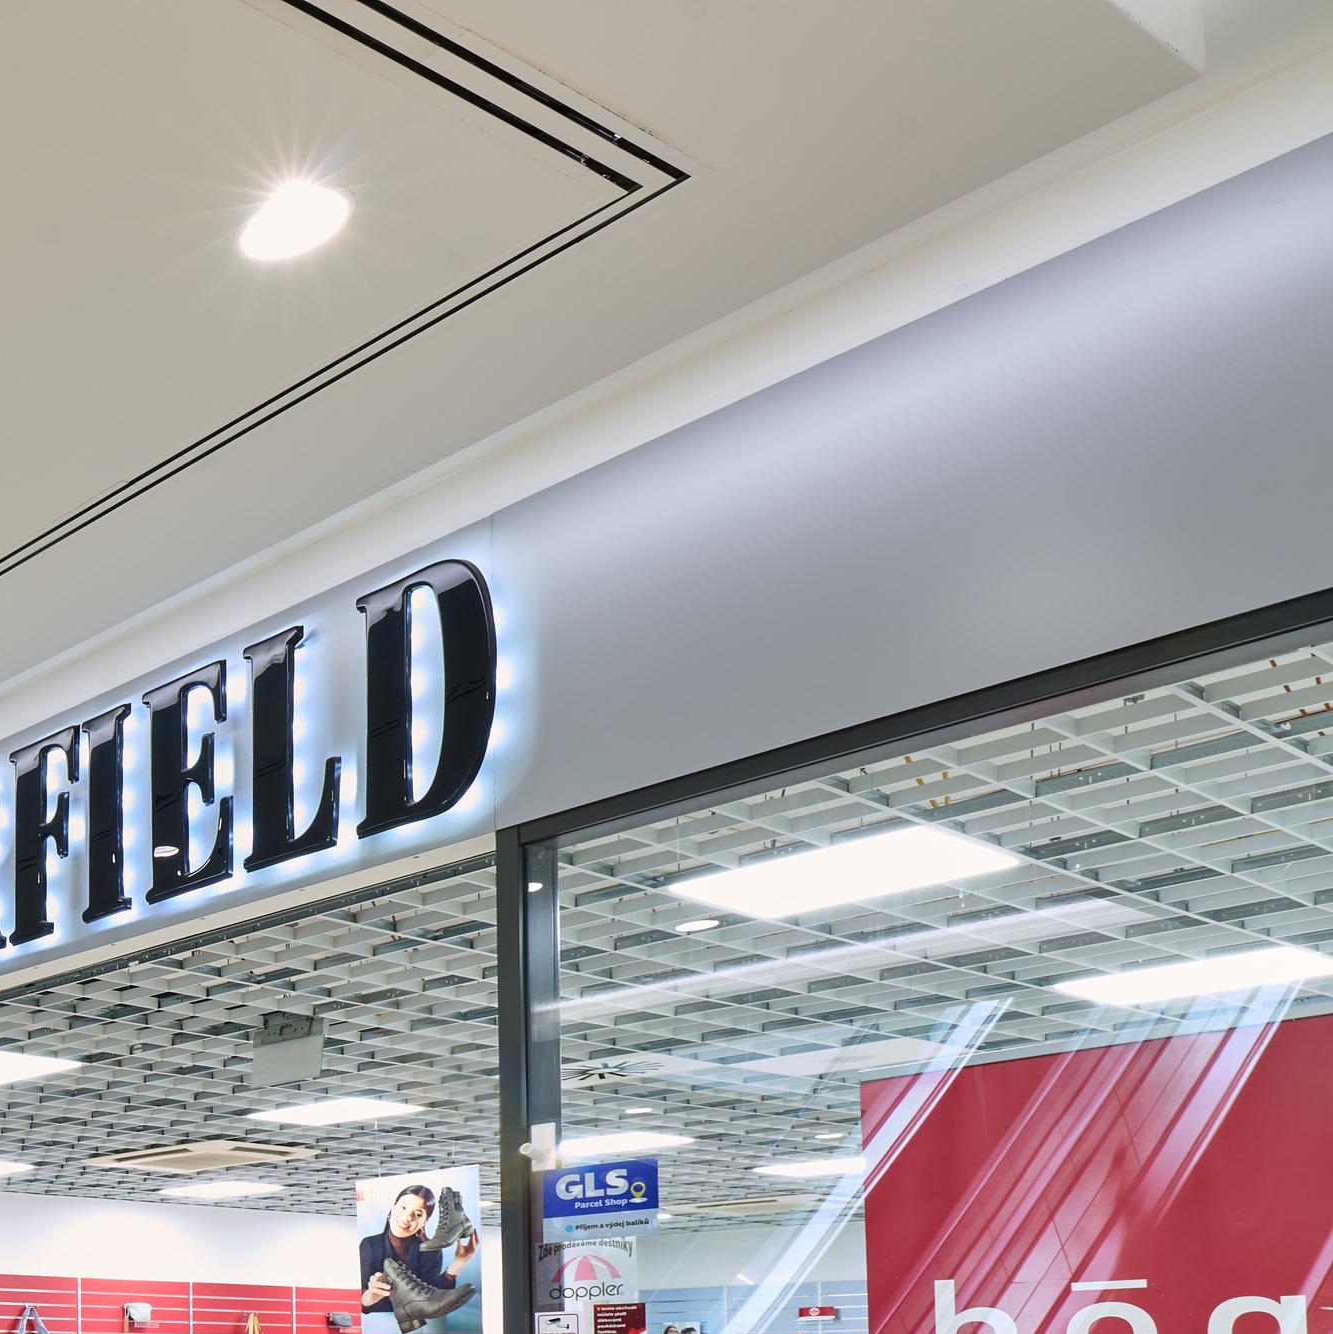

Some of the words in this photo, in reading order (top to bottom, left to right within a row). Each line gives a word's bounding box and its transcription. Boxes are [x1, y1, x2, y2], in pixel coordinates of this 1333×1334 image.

[555, 1169, 629, 1200] GLS
[574, 1200, 603, 1209] Parcel
[605, 1198, 628, 1207] Shop
[538, 1244, 553, 1261] Zde
[549, 1282, 624, 1301] doppler
